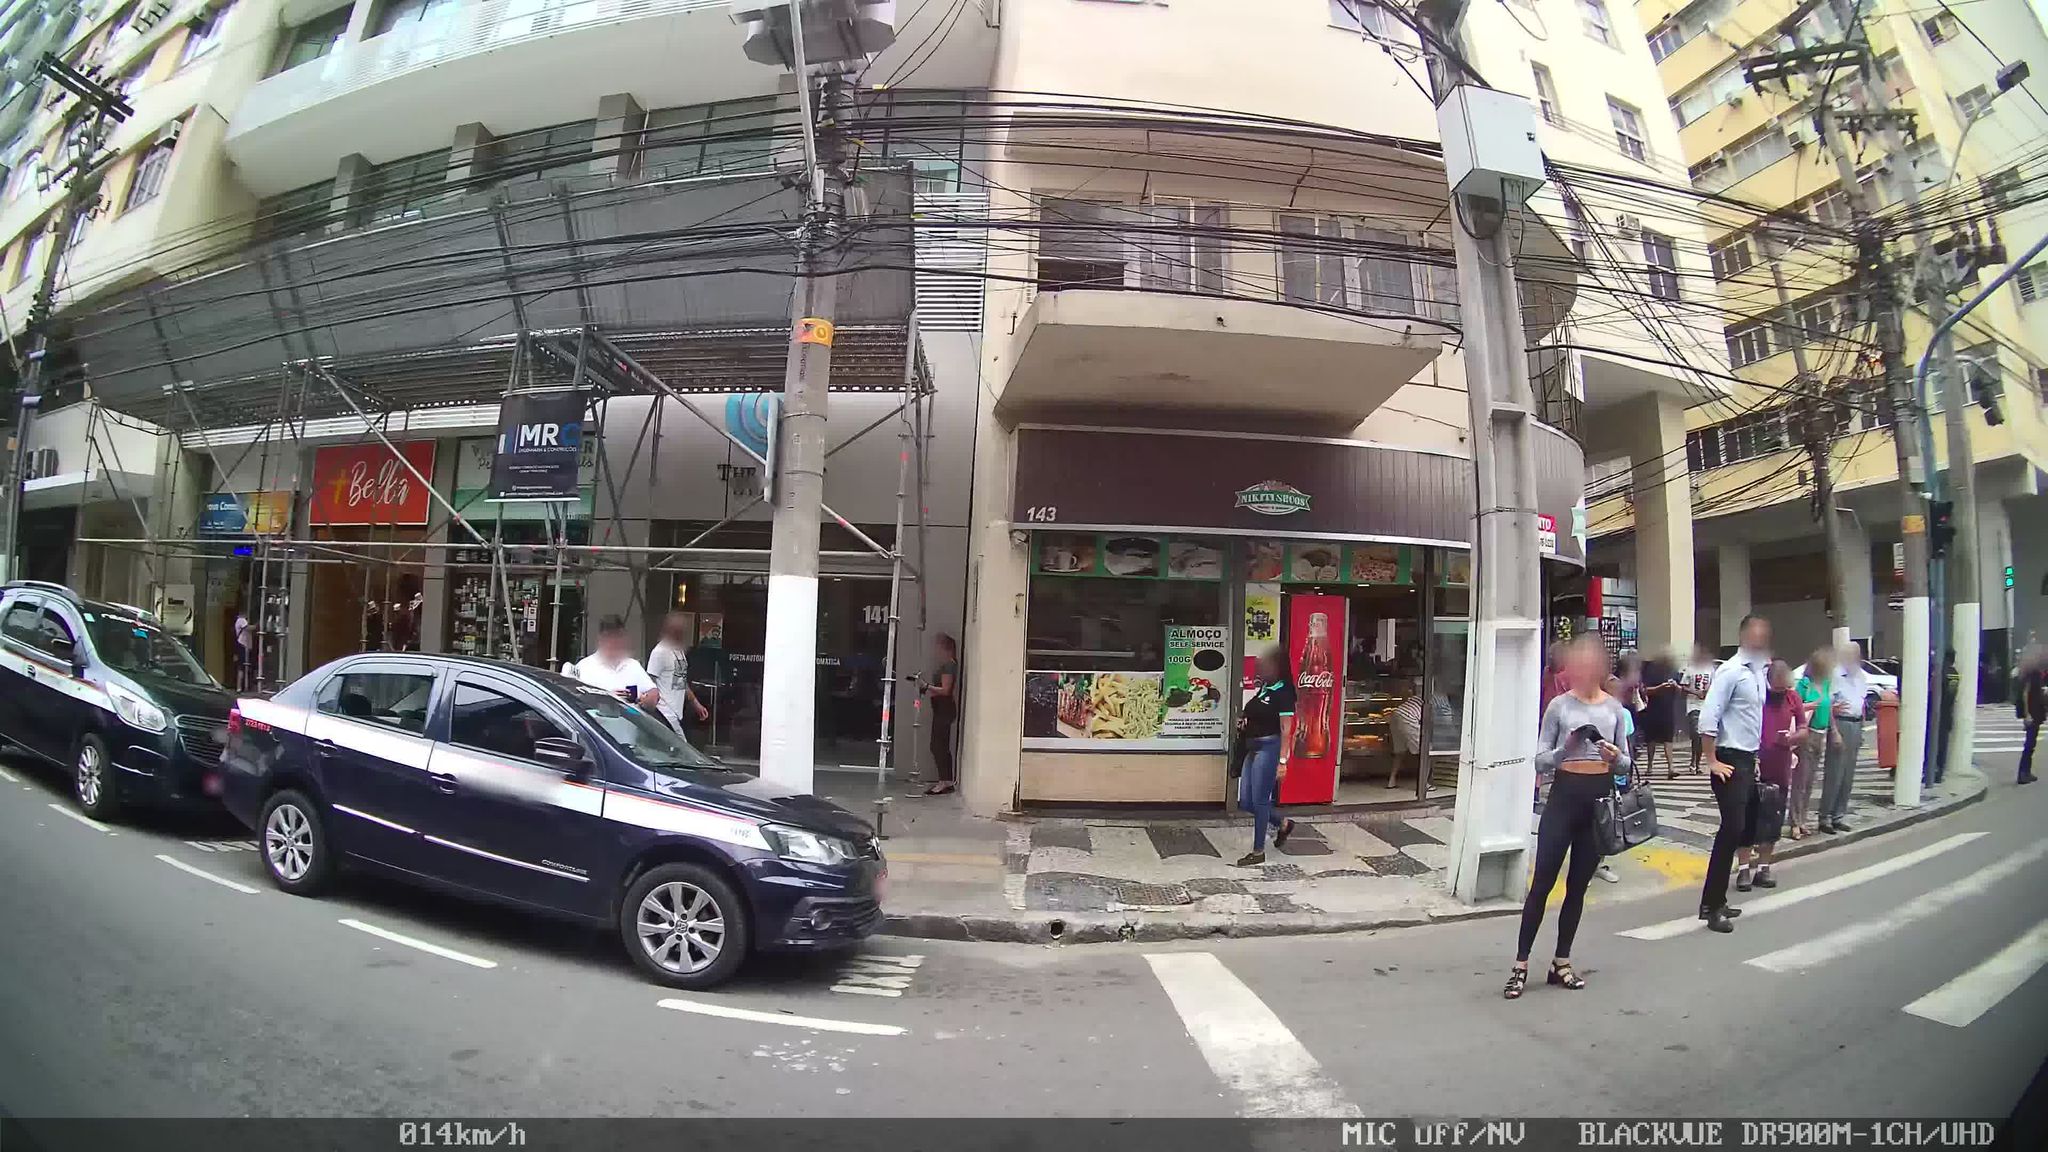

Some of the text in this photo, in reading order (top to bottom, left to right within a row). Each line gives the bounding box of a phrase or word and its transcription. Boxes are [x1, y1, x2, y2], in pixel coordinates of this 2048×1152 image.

[520, 423, 580, 448] MRC
[1027, 506, 1057, 521] 143
[863, 605, 888, 624] 141
[1170, 629, 1222, 641] ALMOÇO
[1169, 641, 1225, 649] SELF SERVICE
[1168, 655, 1191, 664] 100G
